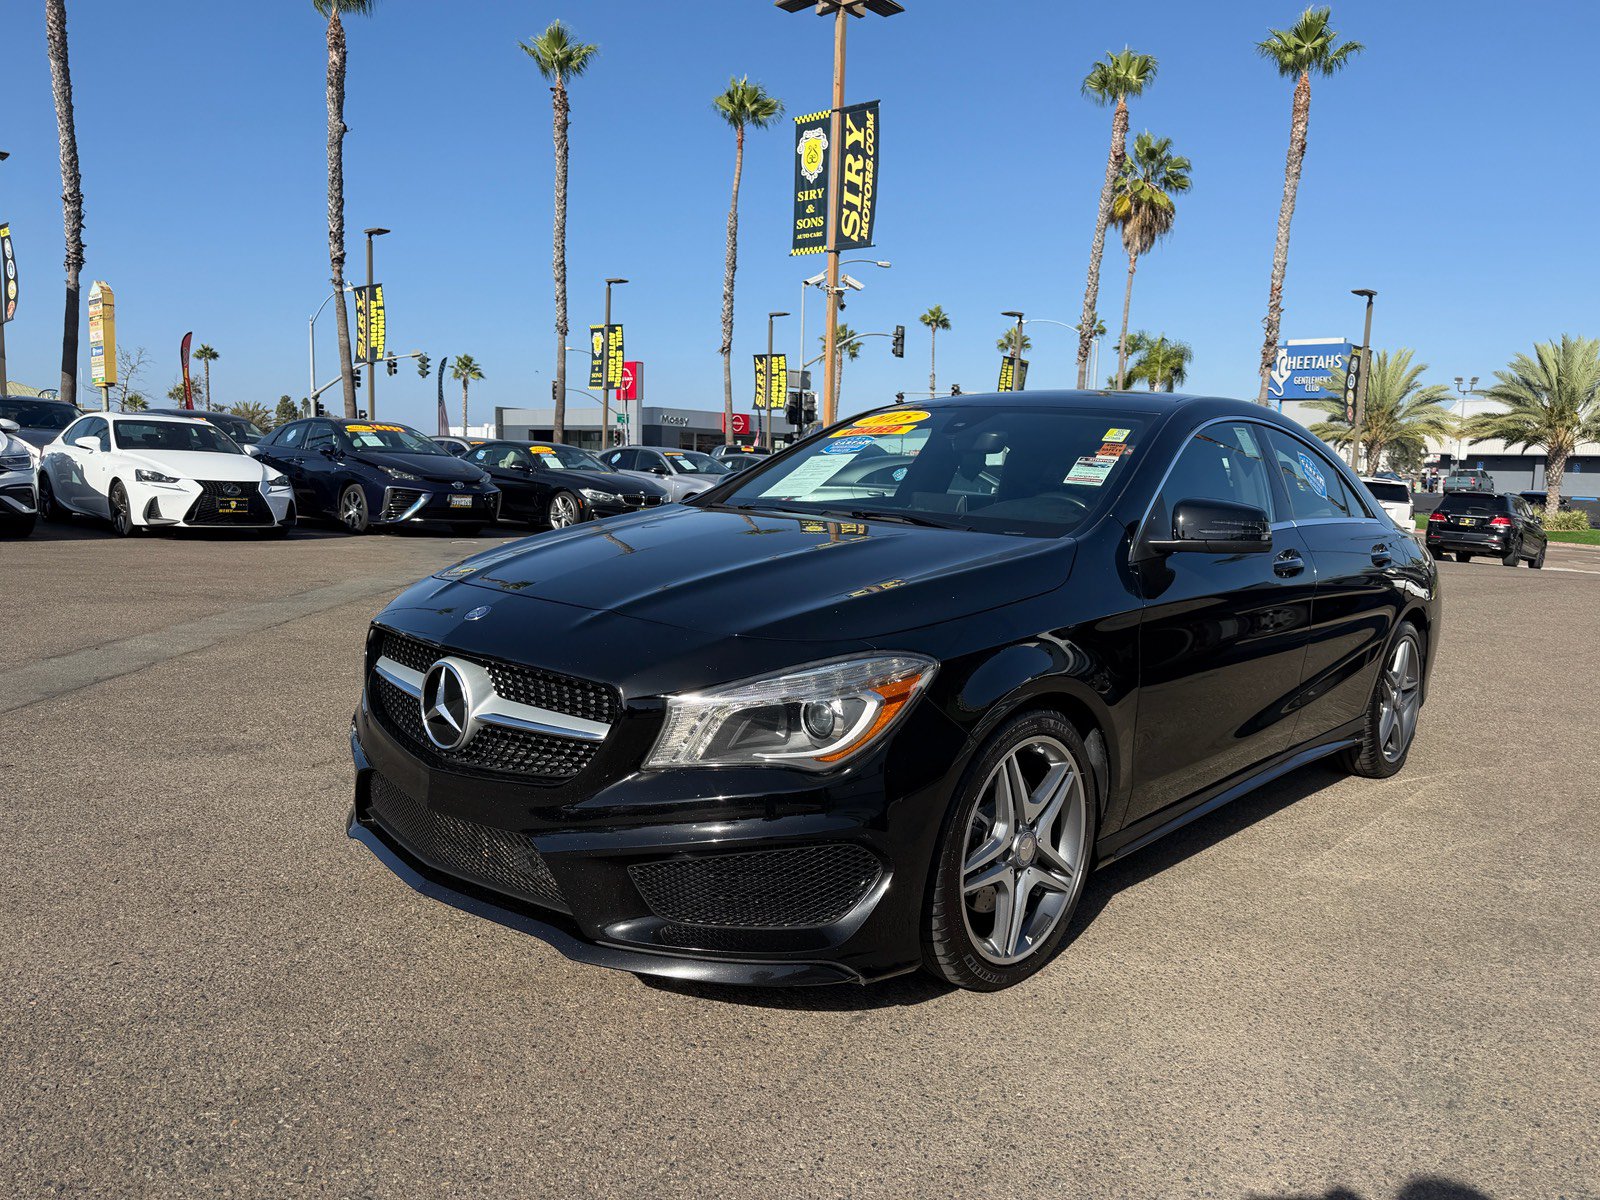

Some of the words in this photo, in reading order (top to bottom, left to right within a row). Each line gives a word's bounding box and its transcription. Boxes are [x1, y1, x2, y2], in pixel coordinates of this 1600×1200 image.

[841, 114, 865, 242] SIRY
[860, 110, 875, 240] MOTORS.COM
[797, 187, 825, 202] SIRY
[805, 204, 816, 214] &
[796, 216, 824, 230] SONS
[375, 286, 384, 307] WE
[370, 300, 378, 348] ANYONE
[376, 309, 385, 360] FINANCE
[608, 332, 616, 357] AUTO
[615, 326, 623, 347] FULL
[607, 358, 616, 382] CARE
[613, 350, 623, 388] SERVICE
[771, 356, 779, 374] OUR
[778, 356, 785, 369] WE
[770, 375, 779, 408] TROOPS
[777, 370, 787, 408] SUPPORT
[661, 414, 689, 428] Mossy
